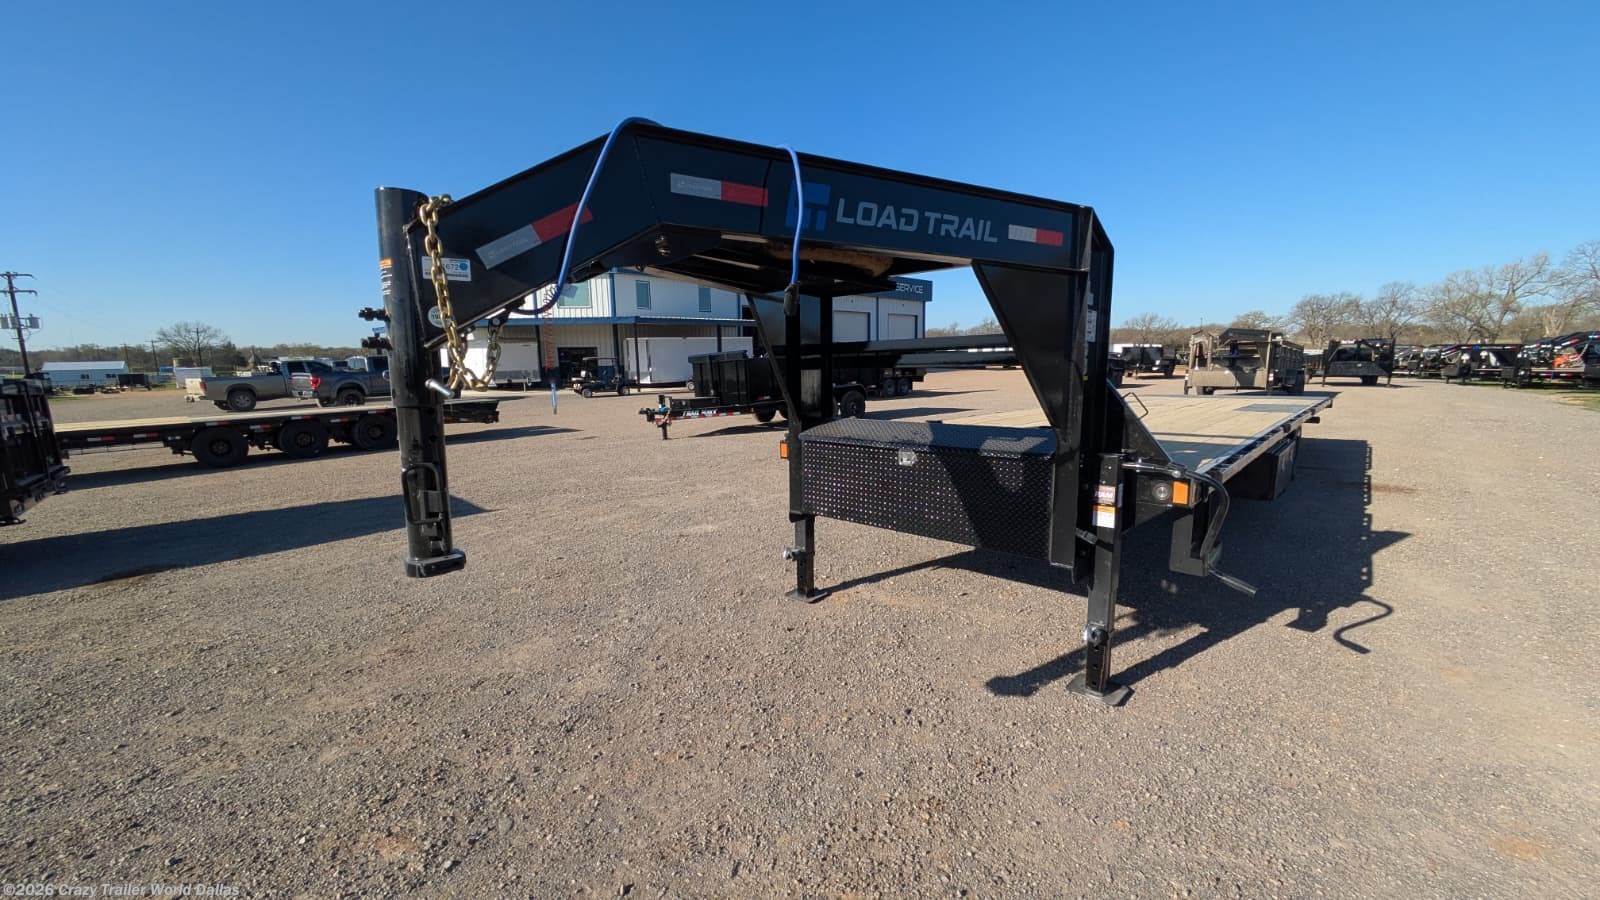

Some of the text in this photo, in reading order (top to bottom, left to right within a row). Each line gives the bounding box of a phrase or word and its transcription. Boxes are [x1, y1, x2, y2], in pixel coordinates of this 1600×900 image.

[836, 198, 998, 243] LOAD TRAIL
[896, 282, 923, 294] SERVICE
